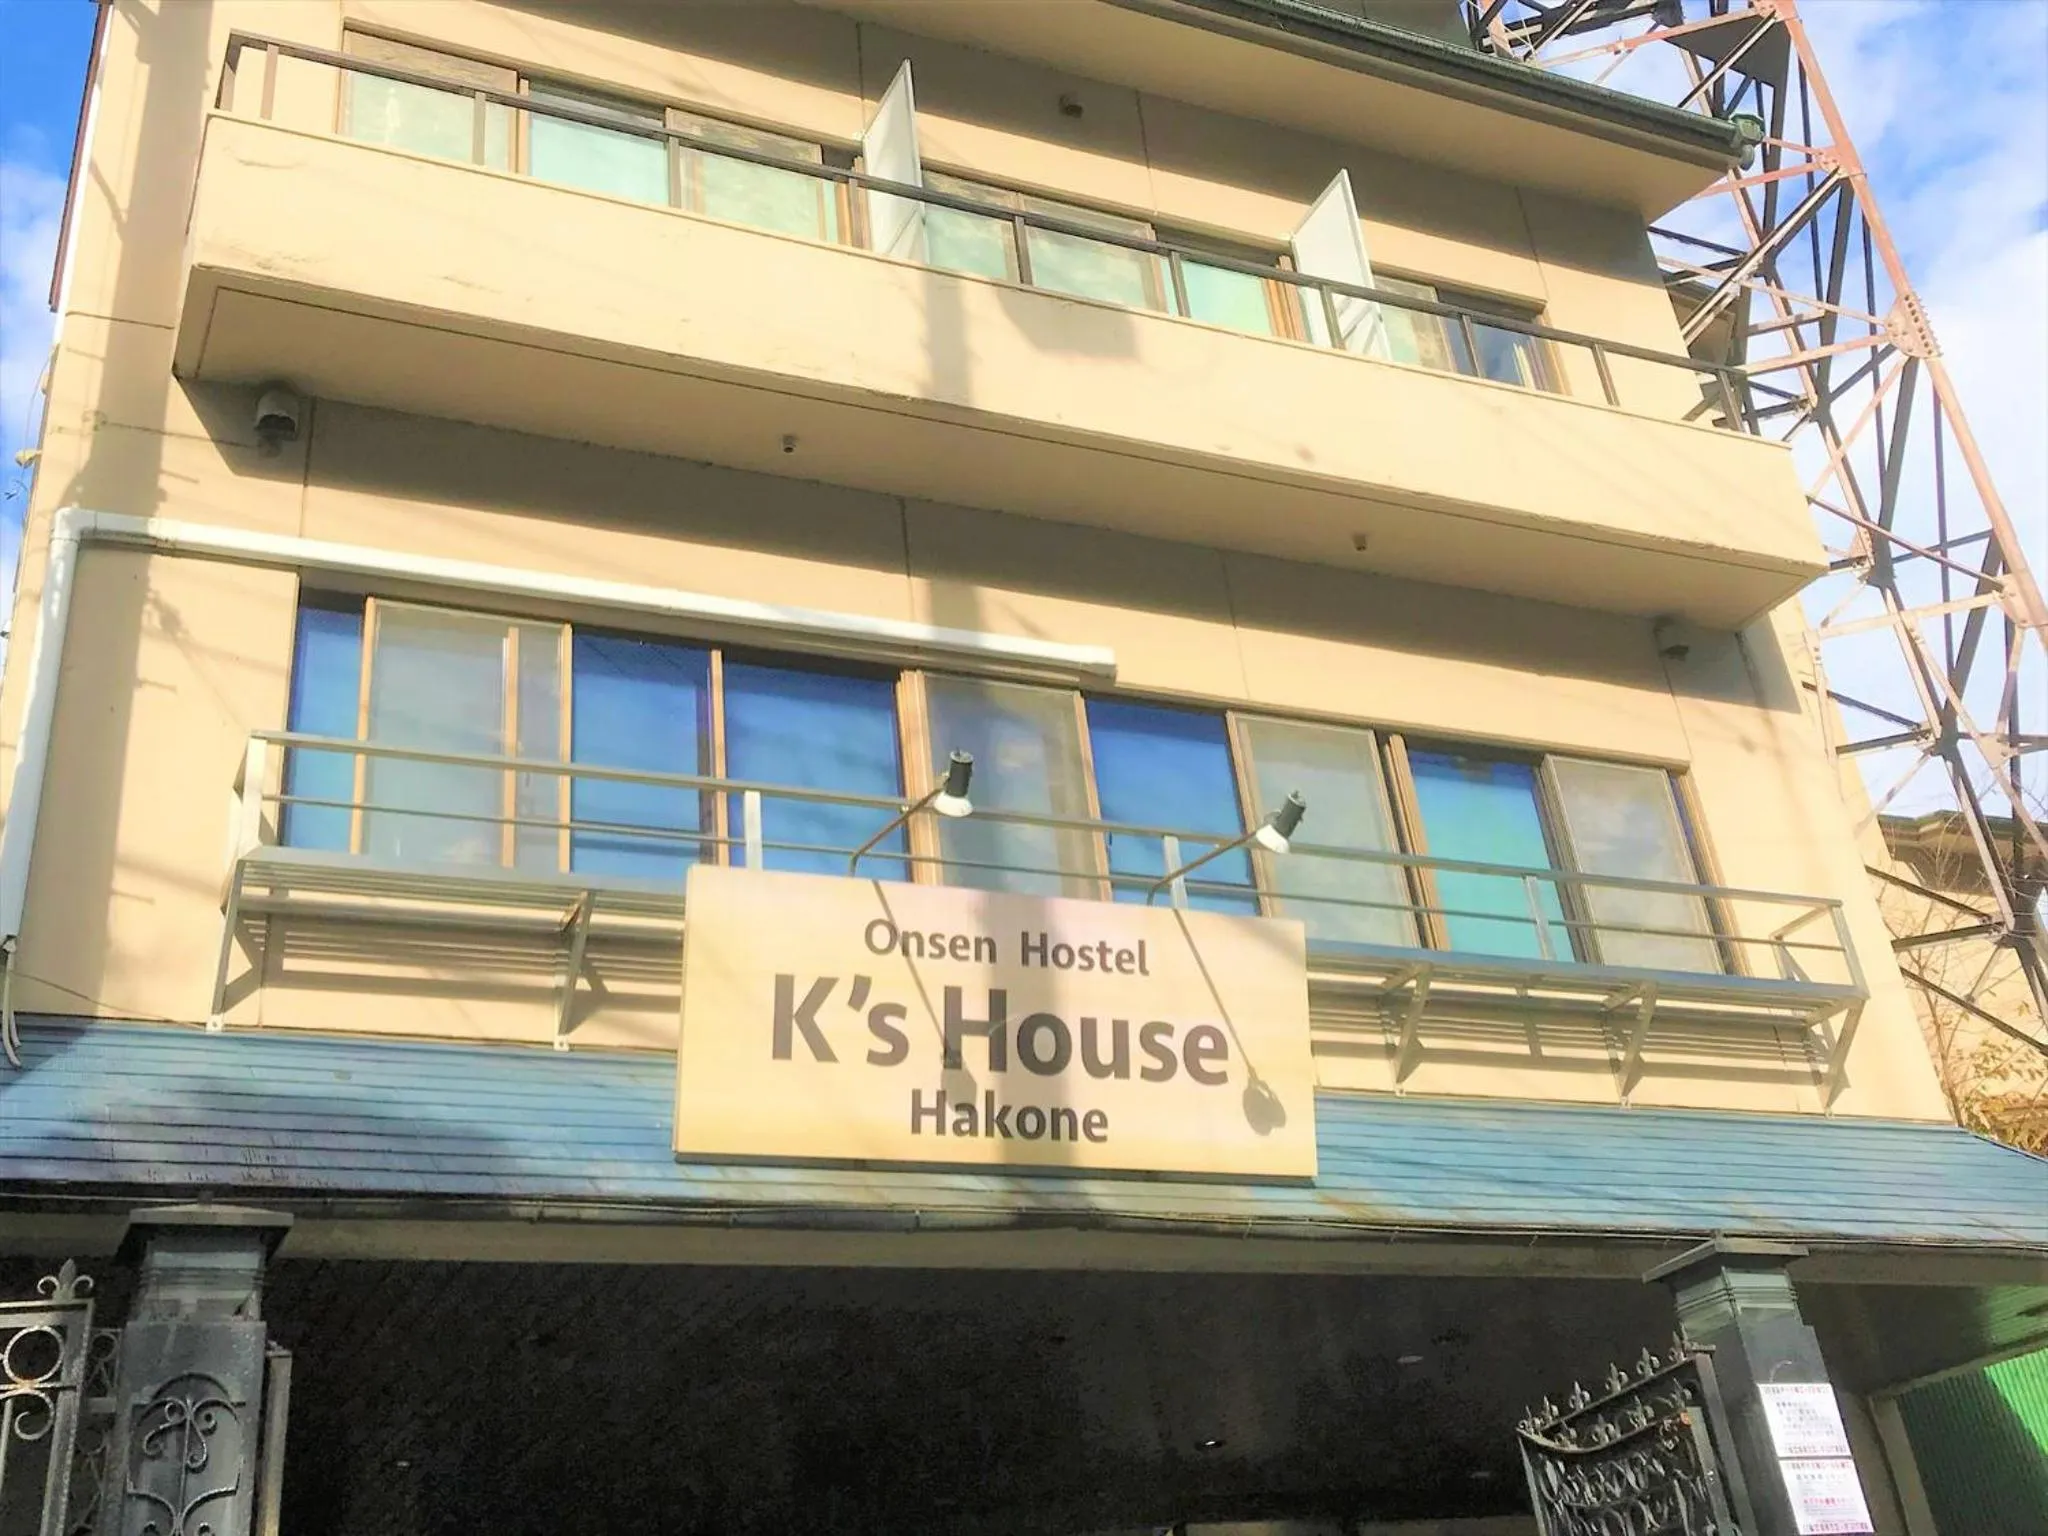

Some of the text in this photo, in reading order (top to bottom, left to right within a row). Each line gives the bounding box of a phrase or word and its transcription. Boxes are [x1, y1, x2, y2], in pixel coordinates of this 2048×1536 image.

[864, 919, 1150, 976] Onsen Hostel
[772, 973, 1229, 1085] K’s House
[912, 1089, 1109, 1143] Hakone
